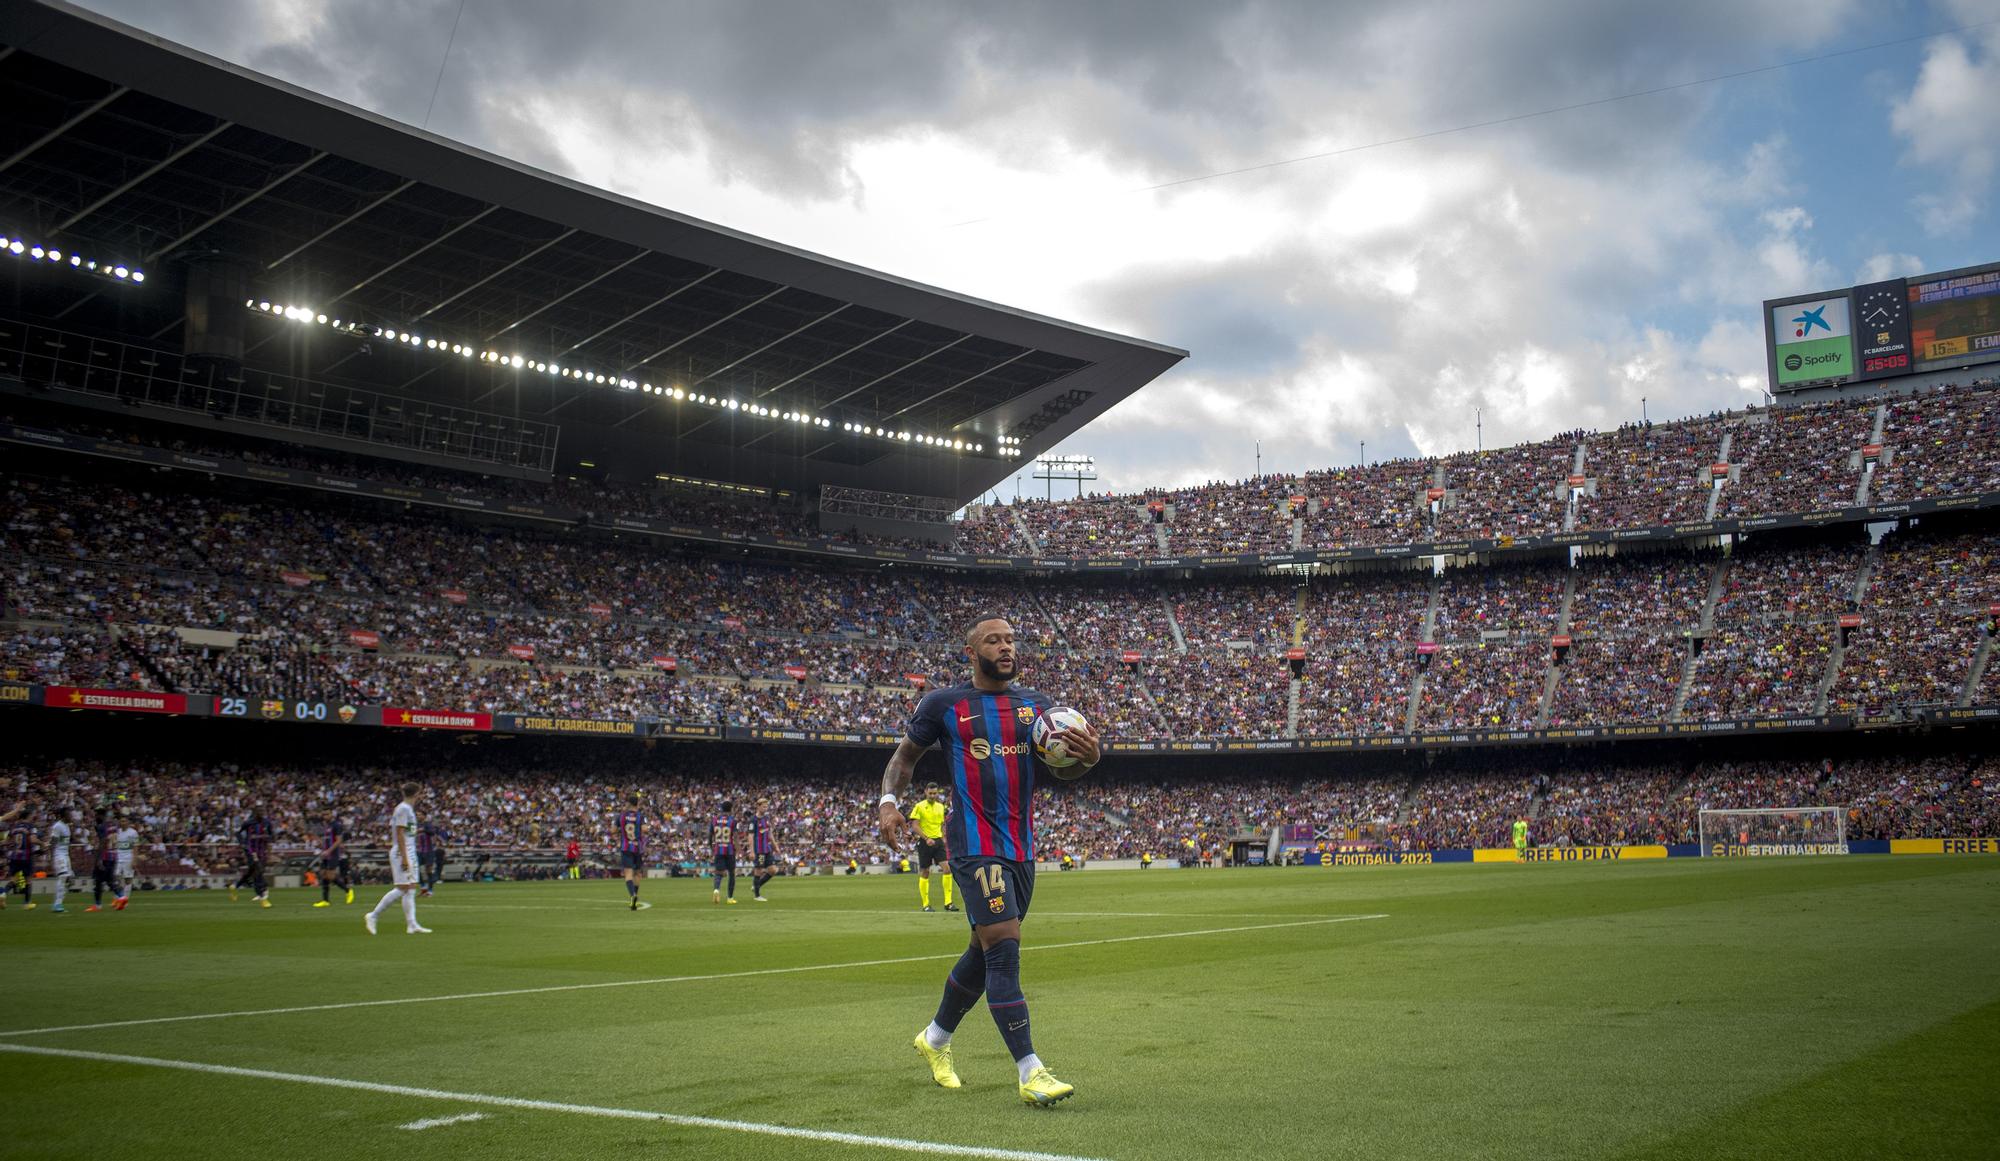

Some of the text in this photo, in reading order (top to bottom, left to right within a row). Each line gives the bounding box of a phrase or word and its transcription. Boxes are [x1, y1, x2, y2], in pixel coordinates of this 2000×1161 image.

[1872, 345, 1905, 353] BARCELONA
[1932, 344, 1947, 357] 15
[1804, 352, 1842, 366] Spotify
[84, 695, 164, 709] ESTRELLA DAMM
[221, 699, 328, 720] 25 0-0
[1950, 710, 1961, 718] MÉS
[1963, 710, 1974, 718] QUE
[412, 715, 475, 726] ESTRELLA DAMM
[525, 717, 634, 733] STORE.FCBARCELONA.COM
[993, 742, 1032, 757] Spotify
[715, 826, 731, 843] 28
[1820, 844, 1849, 855] 2023
[1943, 839, 1989, 853] FREE
[1400, 852, 1432, 865] 2023
[1558, 848, 1578, 861] TO
[1582, 847, 1622, 860] PLAY
[974, 864, 1006, 898] 14
